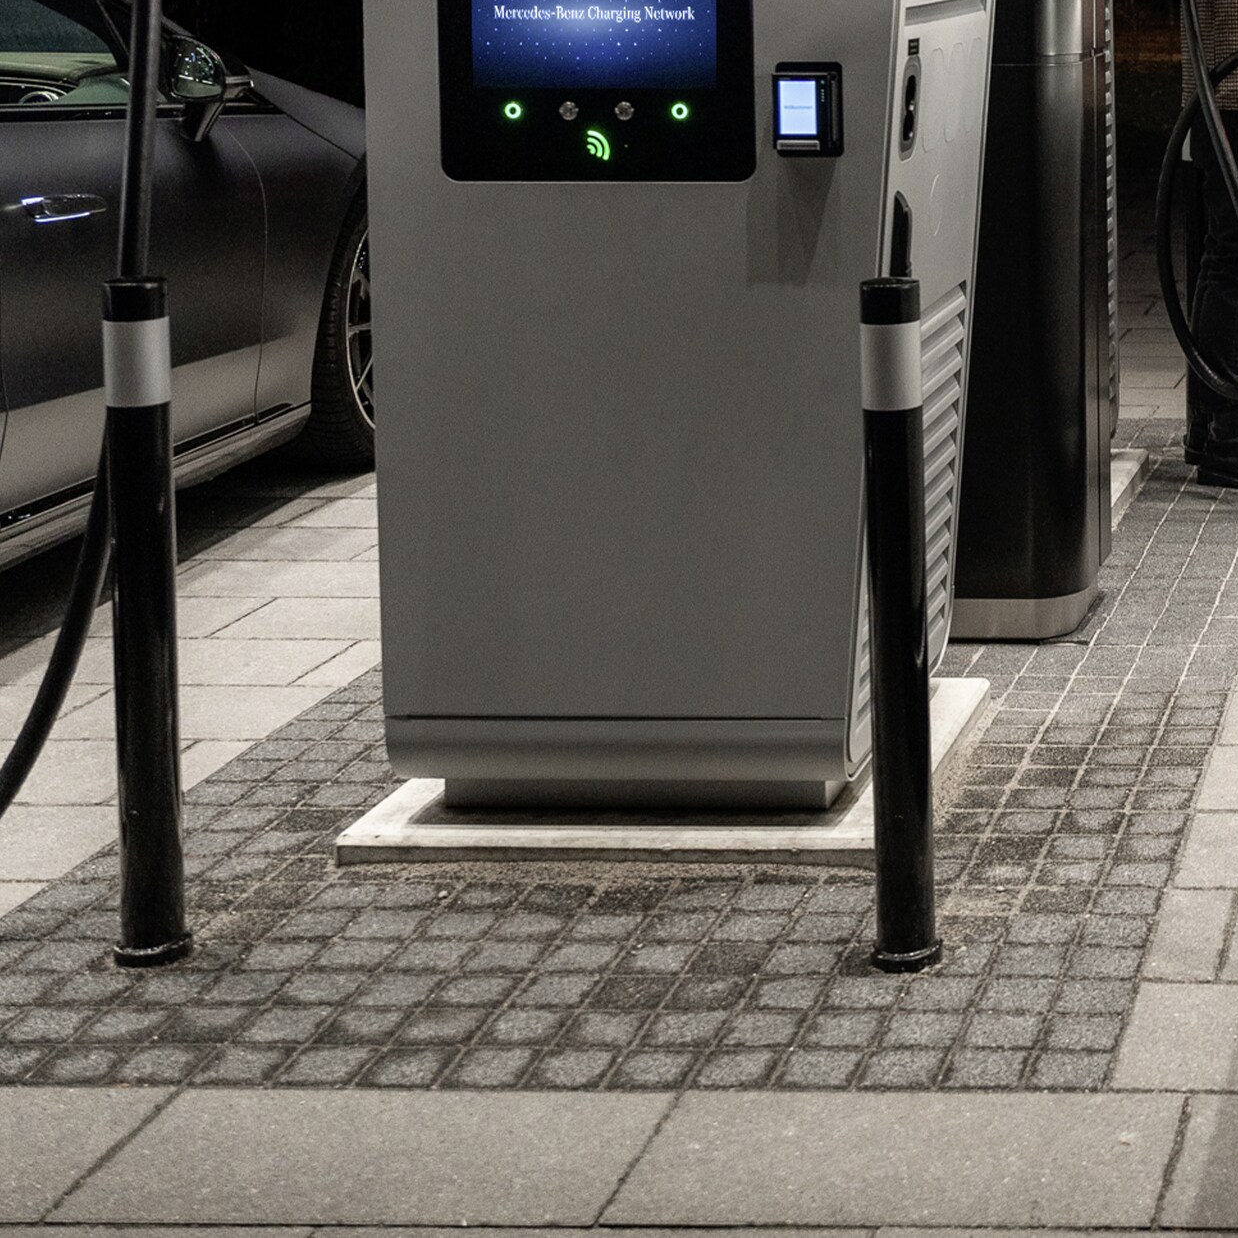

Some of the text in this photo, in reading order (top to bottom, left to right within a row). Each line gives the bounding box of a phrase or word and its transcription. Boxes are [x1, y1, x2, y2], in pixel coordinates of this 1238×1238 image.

[494, 5, 696, 23] Mercedes-Benz Charging Network
